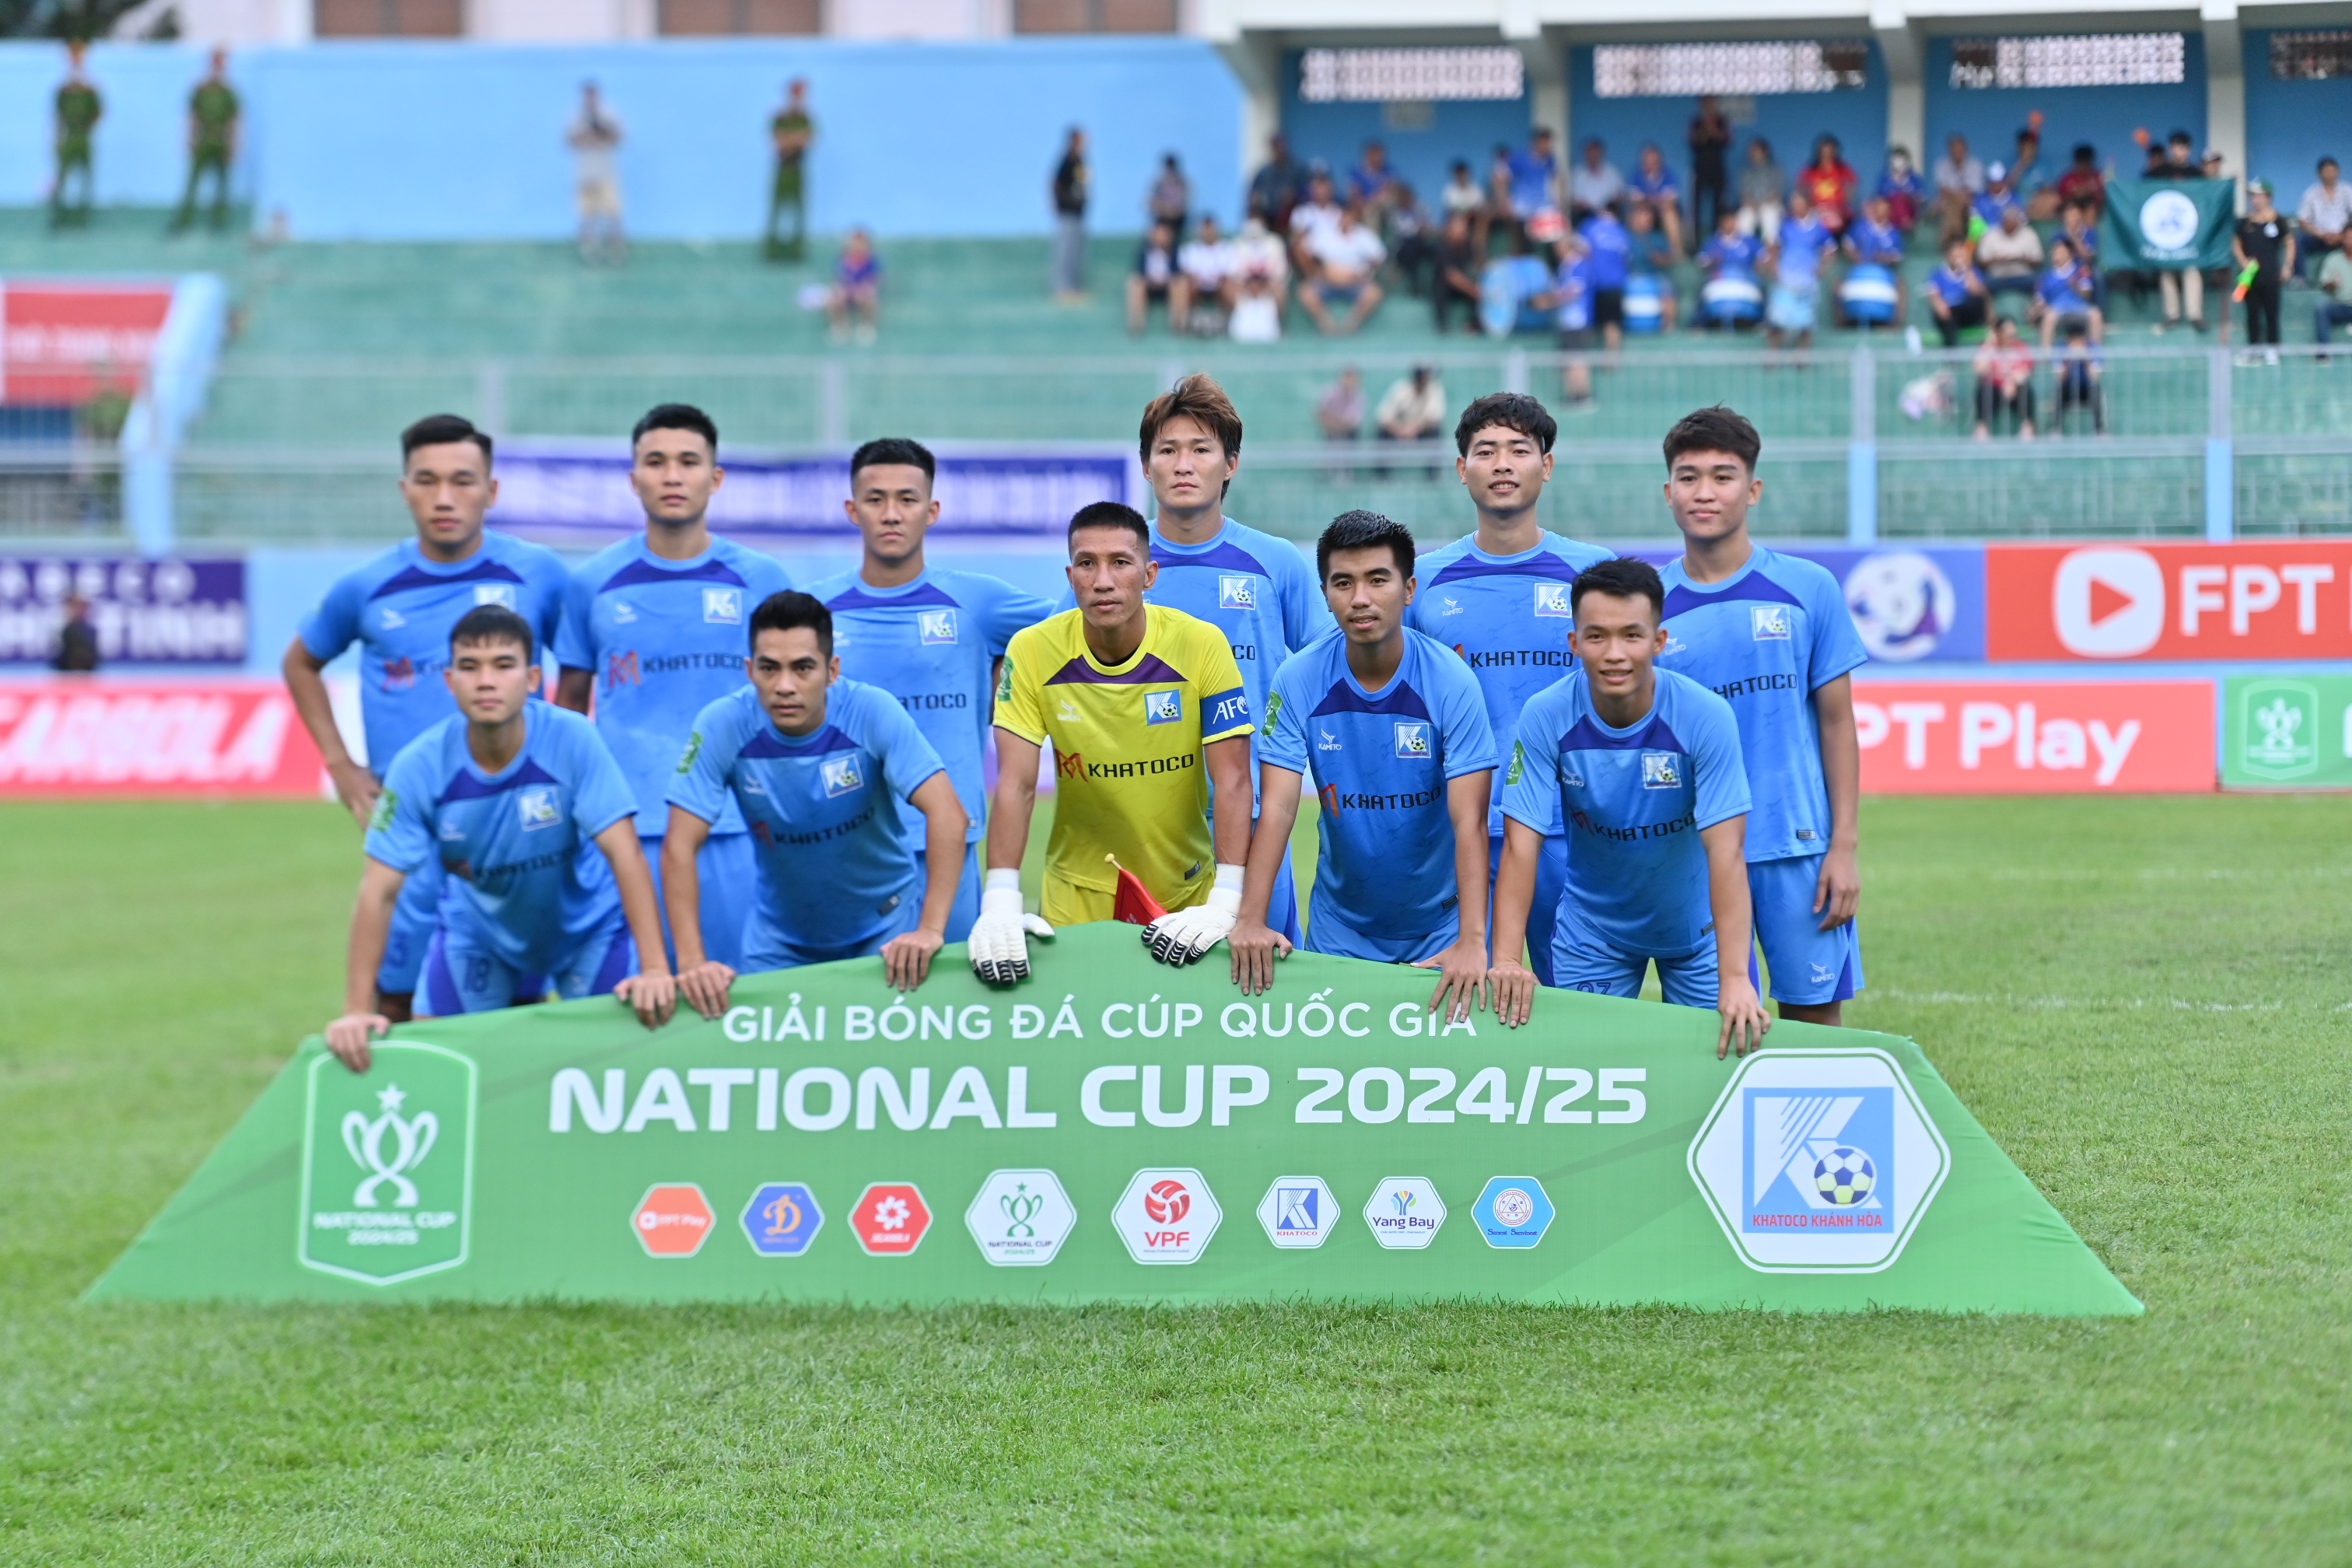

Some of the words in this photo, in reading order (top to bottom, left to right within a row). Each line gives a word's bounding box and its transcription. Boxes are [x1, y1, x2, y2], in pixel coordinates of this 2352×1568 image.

[2181, 564, 2333, 636] FPT
[1470, 650, 1573, 668] KHATOCO
[1709, 674, 1797, 699] HATOCO
[1856, 703, 1946, 769] PT
[1958, 702, 2141, 786] Play
[1089, 754, 1194, 778] KHATOCO
[1342, 786, 1441, 810] KHATOCO
[1594, 812, 1696, 842] KHATOCO
[722, 992, 825, 1042] GIẢI
[844, 995, 992, 1041] BÓNG
[1010, 994, 1083, 1039] ĐÁ
[1101, 993, 1203, 1038] CÚP
[1220, 987, 1370, 1039] QUỐC
[1388, 1002, 1477, 1038] GIA
[549, 1066, 1057, 1133] NATIONAL
[1080, 1064, 1270, 1128] CUP
[1294, 1066, 1647, 1125] 2024/25
[1372, 1216, 1406, 1230] Yang
[1409, 1216, 1435, 1230] Bay
[1752, 1214, 1808, 1227] KHATOCO
[1811, 1212, 1853, 1227] KHÁNH
[1857, 1213, 1883, 1227] HÒA
[1144, 1231, 1190, 1248] VPF
